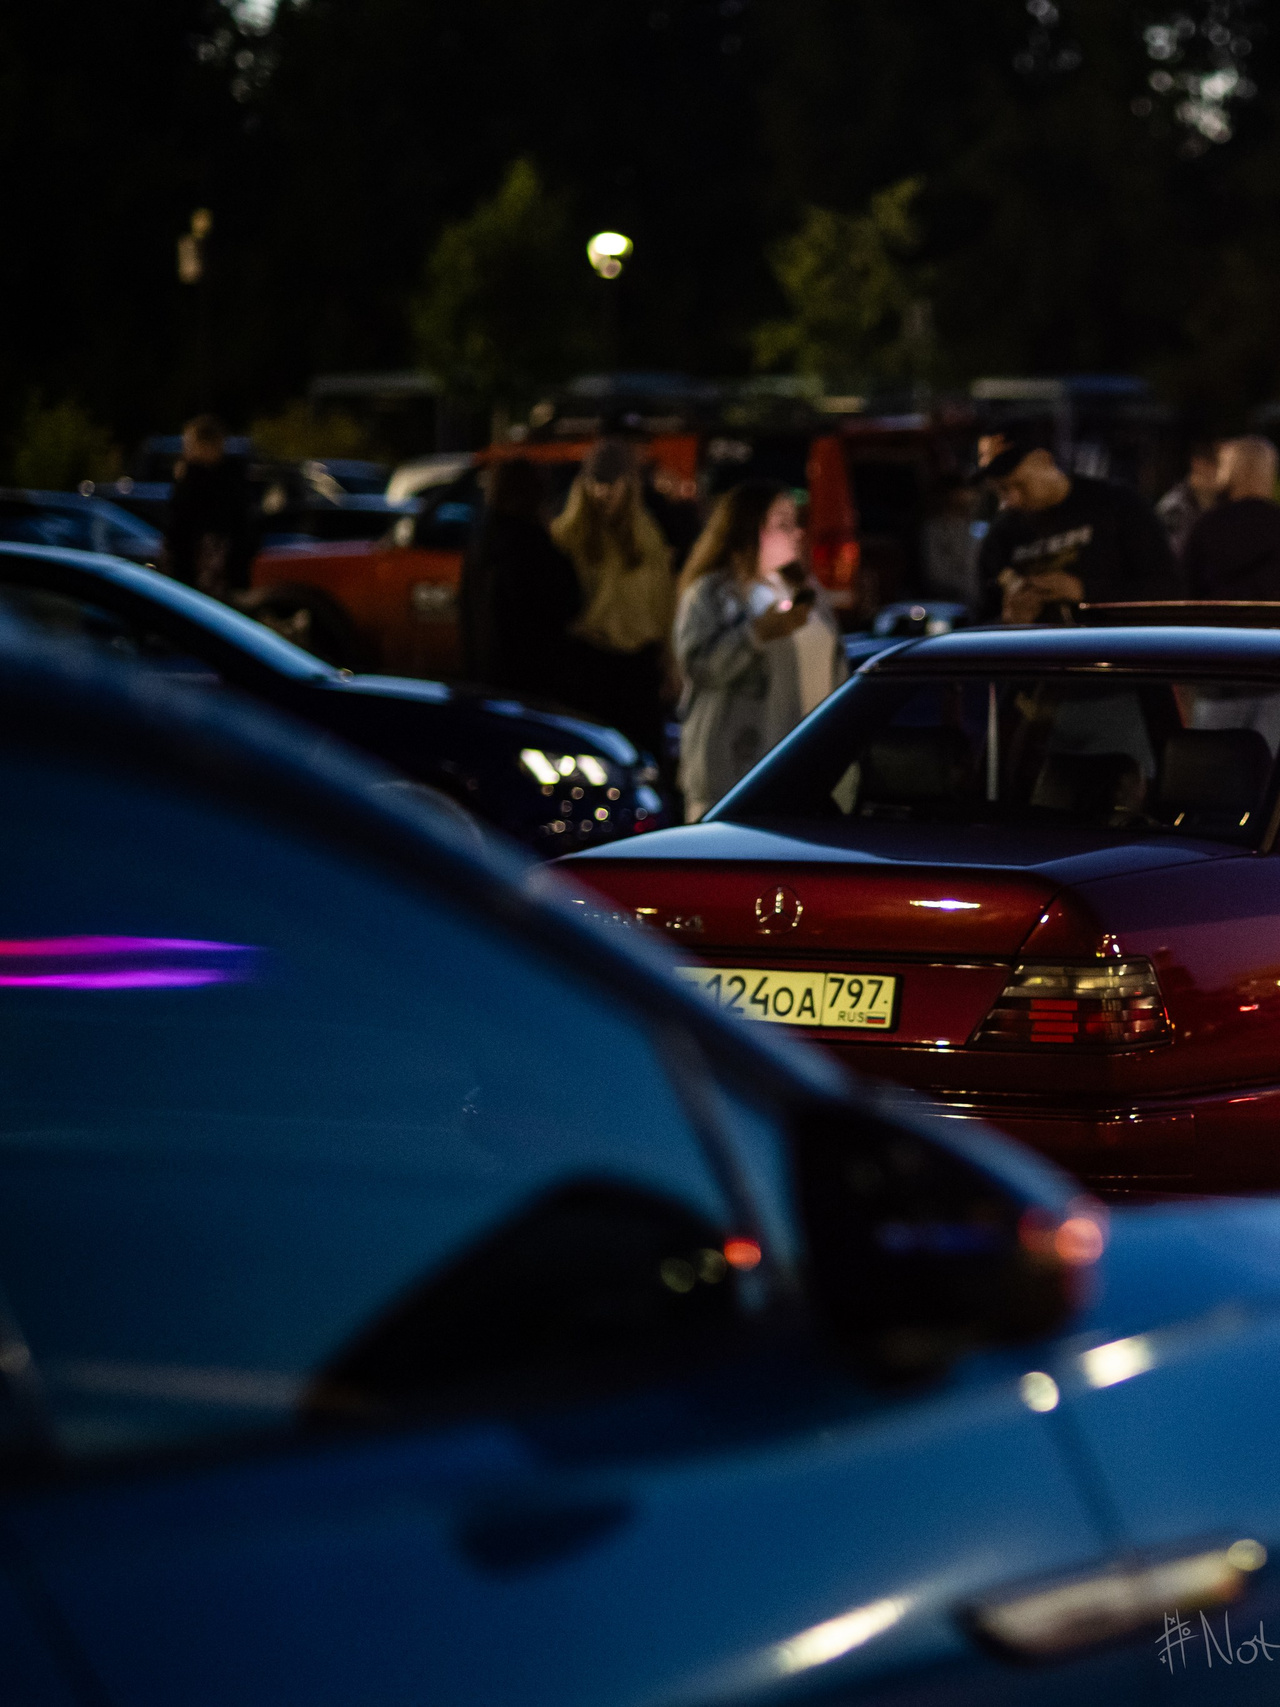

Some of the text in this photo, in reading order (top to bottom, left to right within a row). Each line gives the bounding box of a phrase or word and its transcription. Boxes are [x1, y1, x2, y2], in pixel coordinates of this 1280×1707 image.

[686, 973, 816, 1019] 124OA
[828, 977, 884, 1010] 797
[838, 1011, 866, 1024] RUS
